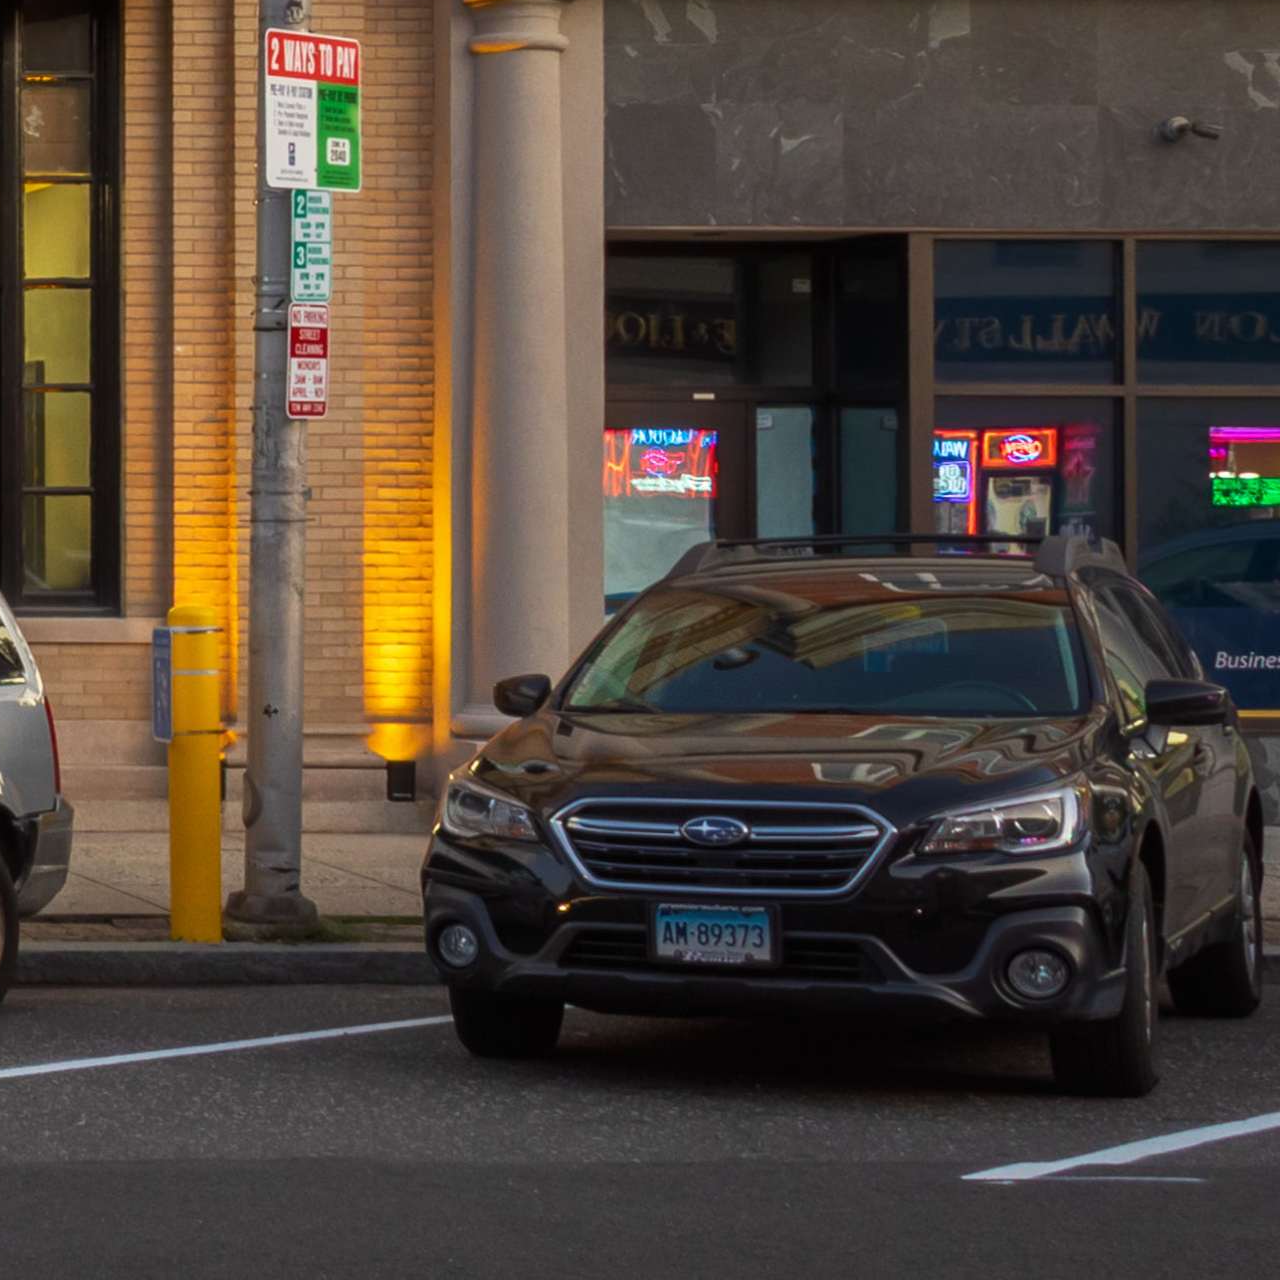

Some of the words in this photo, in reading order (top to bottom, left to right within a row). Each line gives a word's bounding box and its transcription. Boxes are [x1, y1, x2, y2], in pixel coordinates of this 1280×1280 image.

[271, 37, 280, 71] 2
[283, 38, 316, 75] WAYS
[318, 42, 333, 77] TO
[336, 46, 356, 80] PAY
[297, 195, 305, 214] 2
[296, 246, 305, 266] 3
[303, 310, 327, 324] PARKING
[299, 329, 321, 341] STREET
[295, 343, 324, 355] CLEANING
